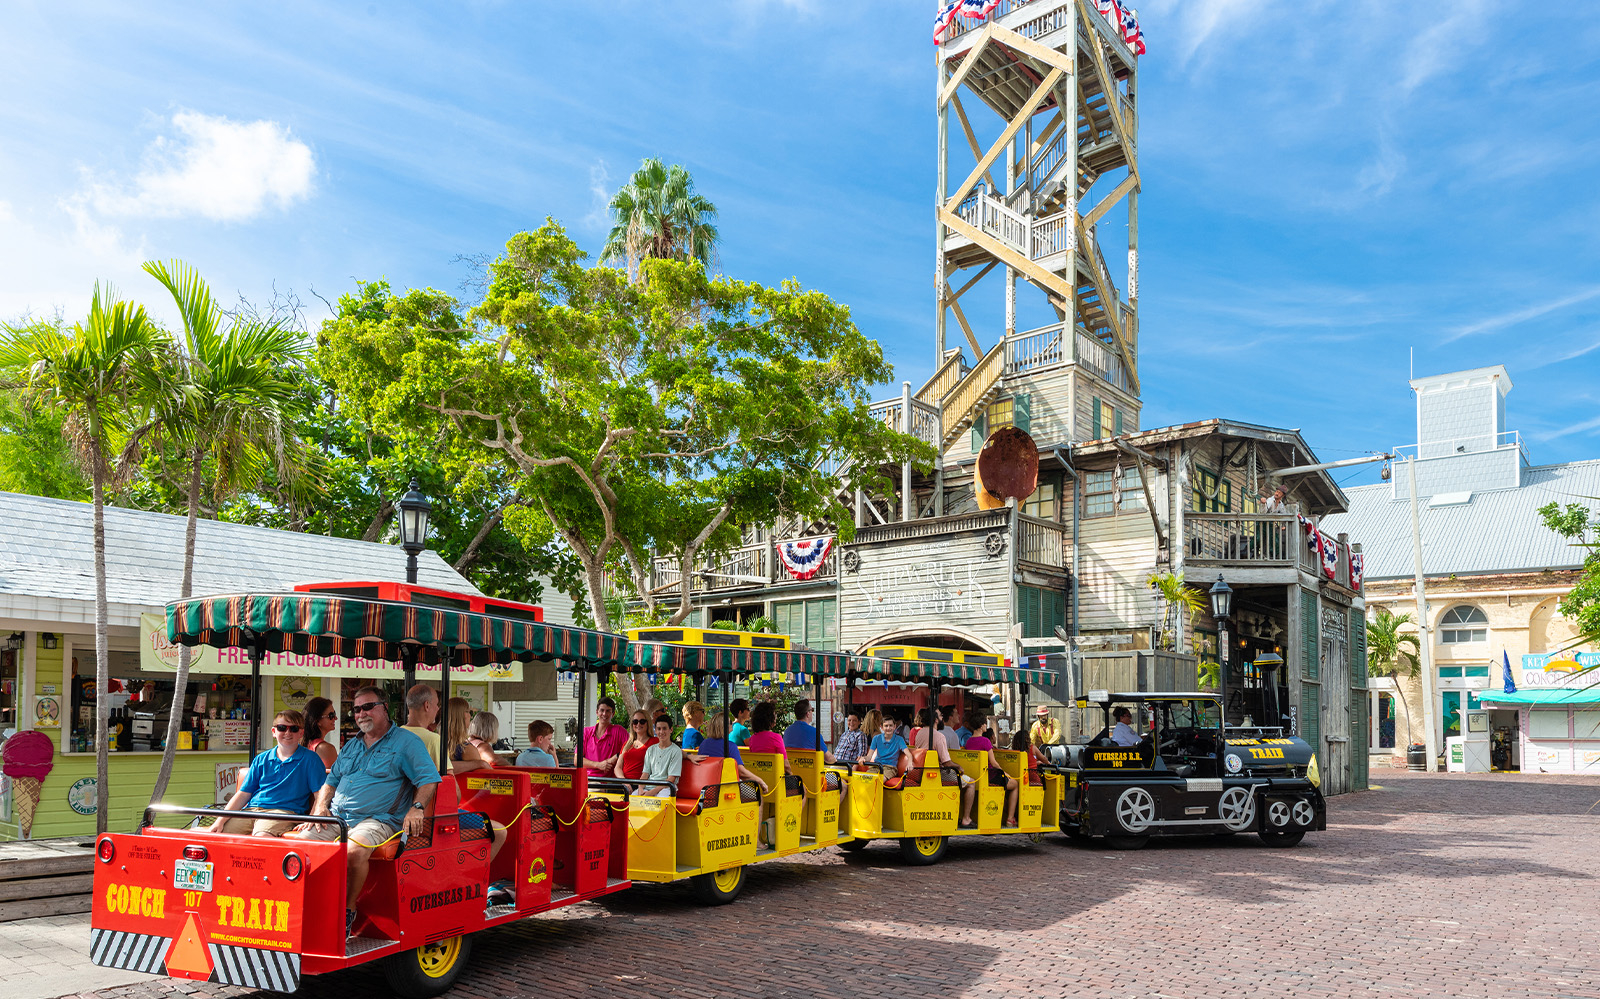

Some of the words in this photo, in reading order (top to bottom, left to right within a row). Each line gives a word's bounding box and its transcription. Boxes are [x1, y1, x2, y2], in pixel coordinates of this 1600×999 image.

[856, 560, 994, 618] SHIPWRECK
[886, 589, 953, 604] TREASURES
[874, 600, 964, 618] MUSEUM
[217, 646, 271, 665] FREH
[277, 651, 342, 668] FLORIDA
[1527, 656, 1545, 668] KEY
[1579, 655, 1600, 666] WES
[1526, 671, 1561, 686] CONCH
[1093, 752, 1128, 761] OVERSEAS
[1128, 752, 1143, 761] R.R.
[1248, 747, 1285, 759] TRAIN
[74, 778, 98, 790] KEY
[490, 779, 513, 787] CAUTION
[72, 802, 98, 814] LIMEA
[910, 811, 941, 821] OVERSEAS
[706, 835, 739, 852] OVERSEAS
[739, 833, 752, 846] R.R.
[106, 882, 167, 919] CONCH
[183, 890, 203, 908] 107
[409, 887, 463, 914] OVERSEAS
[465, 883, 484, 901] R.R.
[216, 894, 290, 932] TRAIN
[210, 932, 292, 949] WWW.CONCHTOURTRAIN.COM
